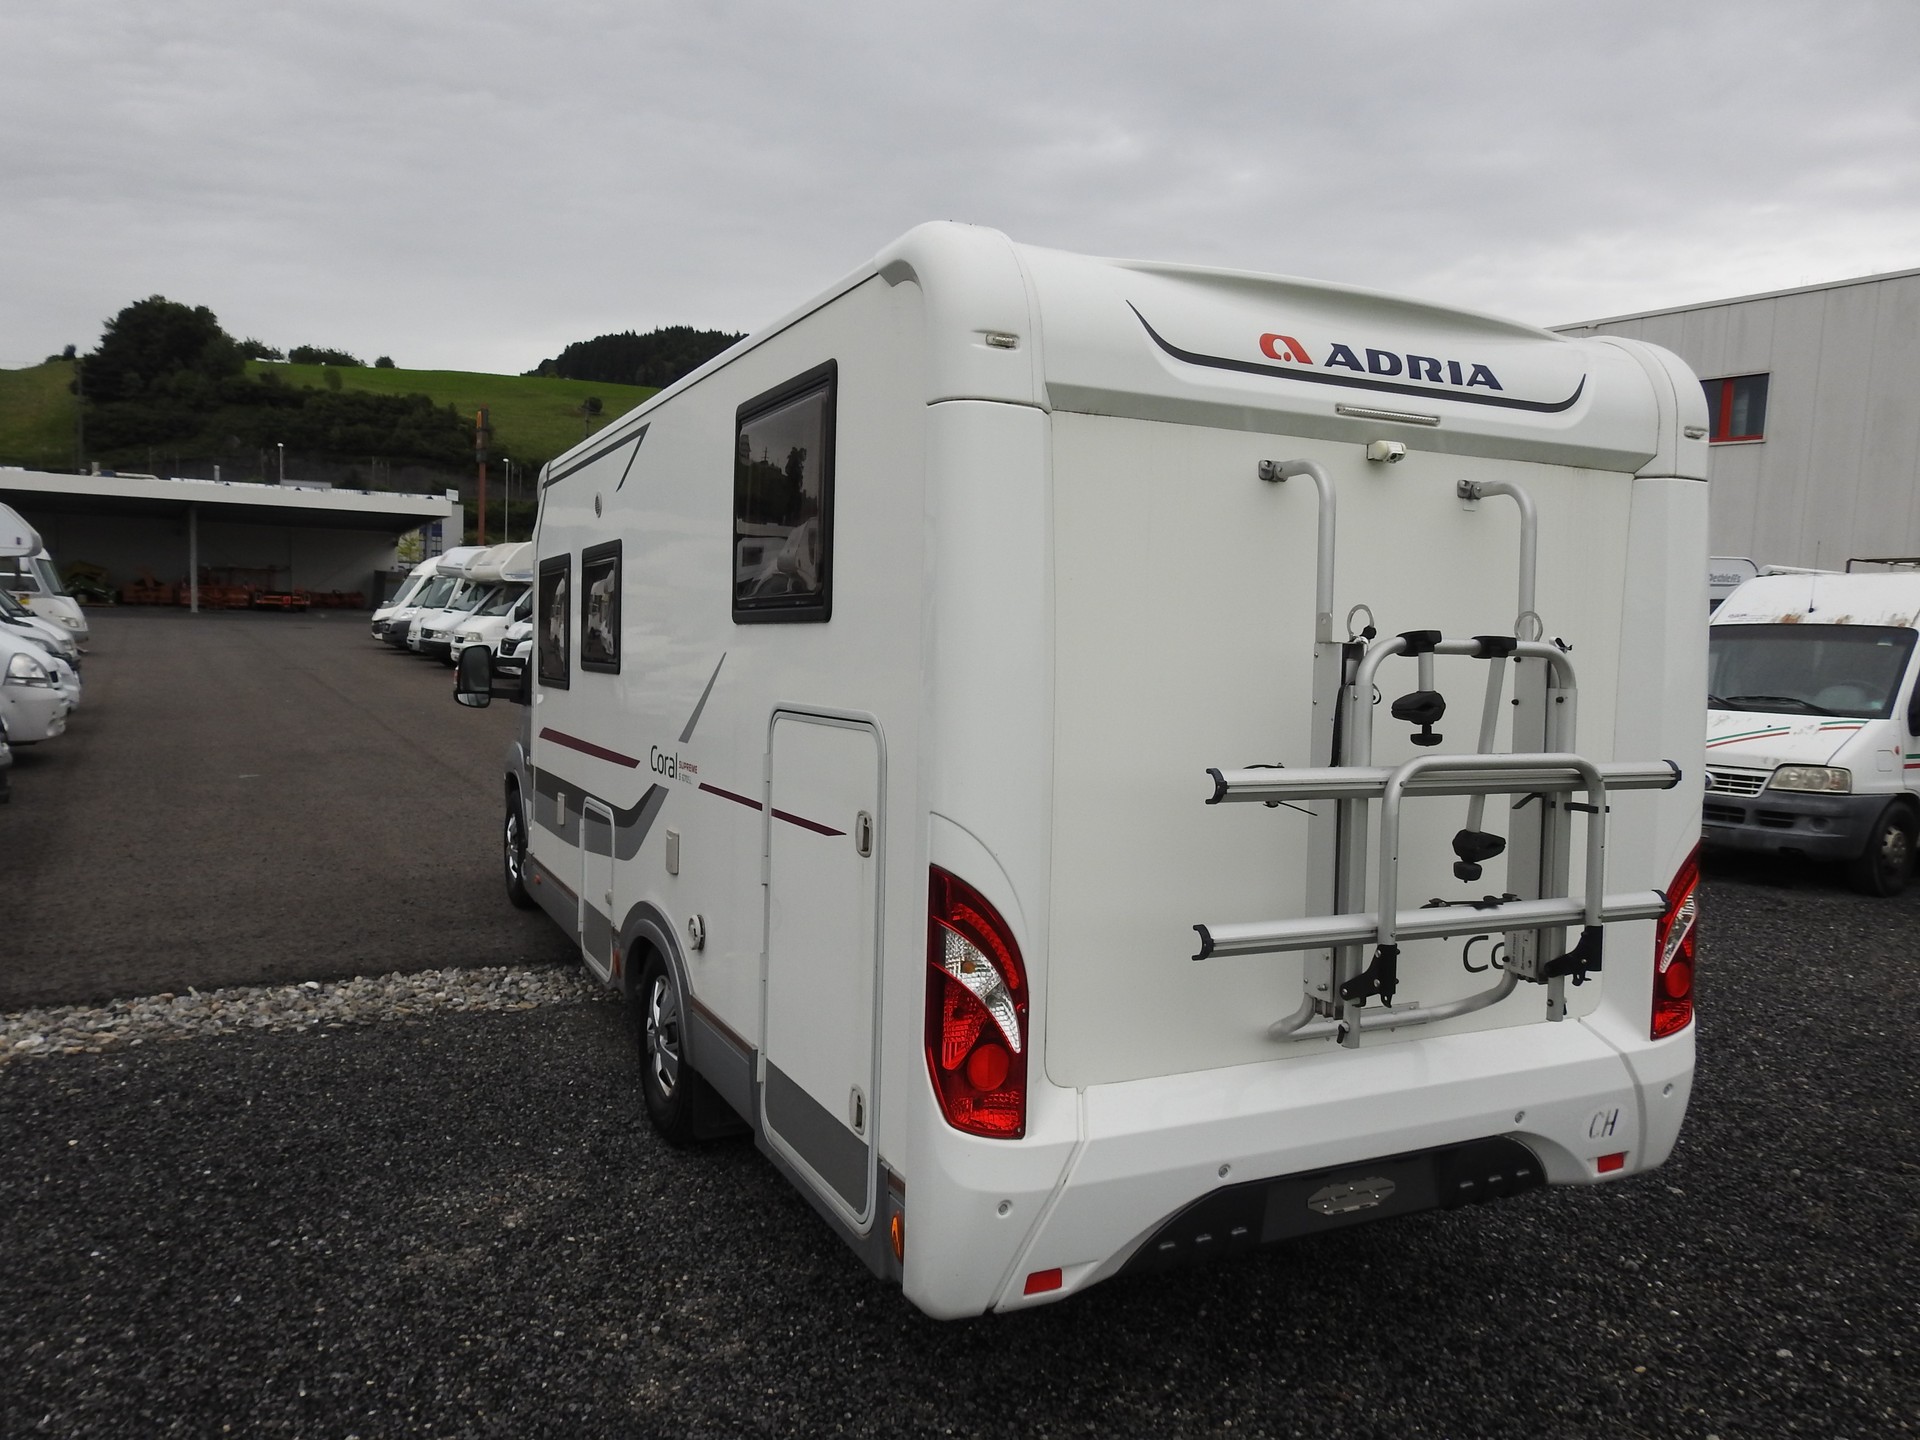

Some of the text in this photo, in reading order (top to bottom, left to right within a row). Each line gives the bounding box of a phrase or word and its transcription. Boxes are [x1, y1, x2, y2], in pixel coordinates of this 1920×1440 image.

[1324, 342, 1503, 391] ADRIA
[650, 744, 678, 780] Coral
[678, 760, 698, 774] SUPREME
[1589, 1108, 1619, 1138] CH
